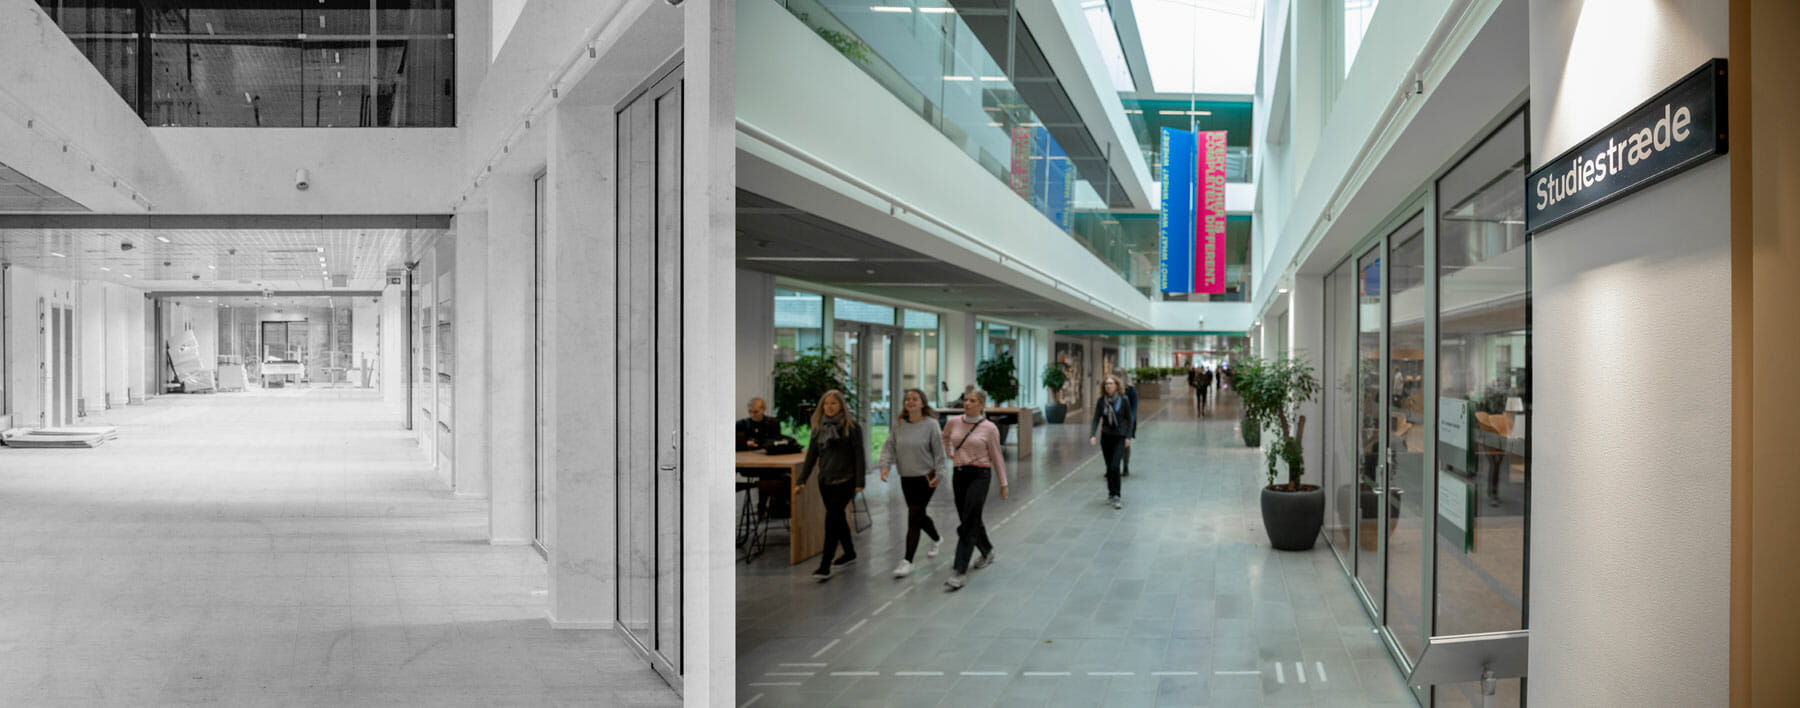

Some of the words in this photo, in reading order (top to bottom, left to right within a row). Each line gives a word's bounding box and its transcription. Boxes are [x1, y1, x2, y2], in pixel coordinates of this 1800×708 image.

[1162, 130, 1170, 166] WHERE?
[1215, 132, 1225, 172] EVERY
[1536, 104, 1691, 211] Studiestræde
[1162, 169, 1170, 200] WHEN?
[1205, 132, 1216, 211] COMPLETELY
[1215, 178, 1225, 217] OTHER
[1161, 231, 1169, 260] WHAT?
[1215, 221, 1225, 234] IS
[1205, 216, 1216, 287] DIFFERENT.
[1161, 263, 1169, 289] WHO?
